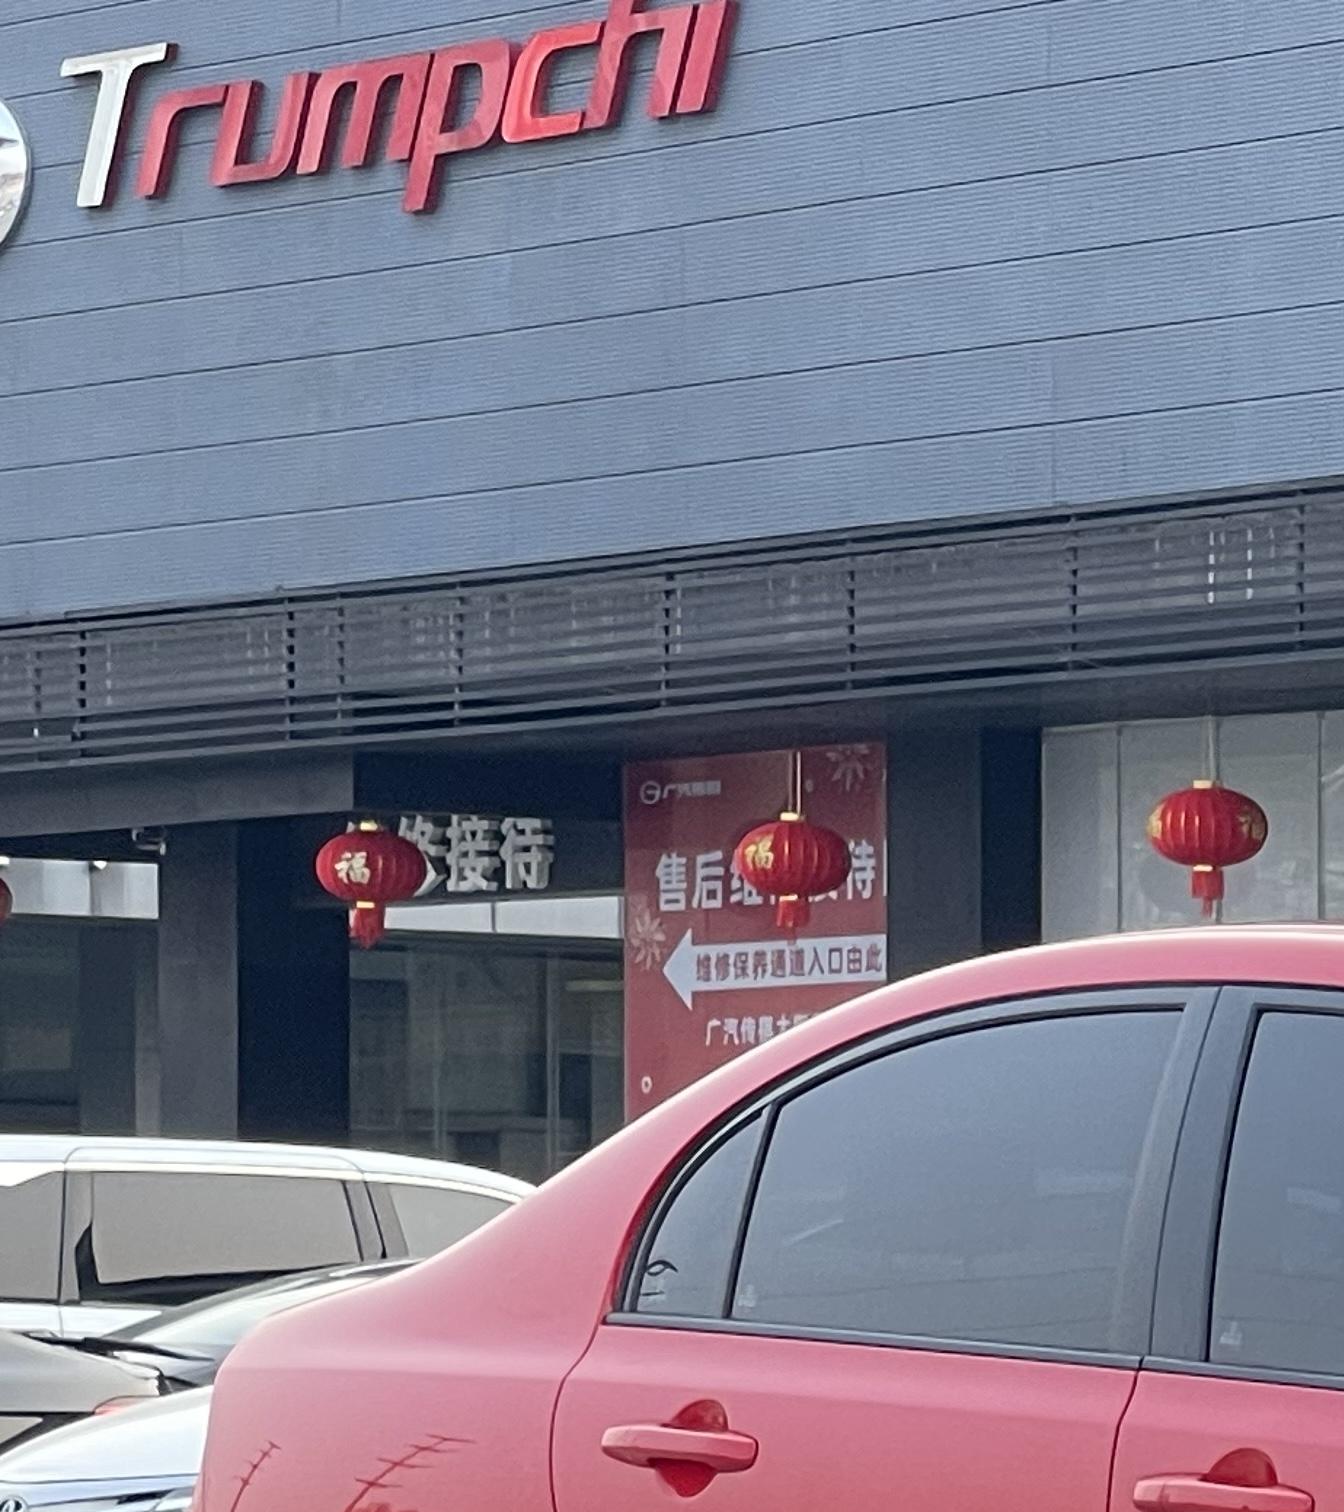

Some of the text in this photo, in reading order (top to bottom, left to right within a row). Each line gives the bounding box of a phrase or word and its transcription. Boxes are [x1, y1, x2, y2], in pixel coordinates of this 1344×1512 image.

[60, 0, 738, 214] Trumpchi
[334, 851, 372, 885] 福
[696, 943, 884, 983] 维修保养通道入口由此
